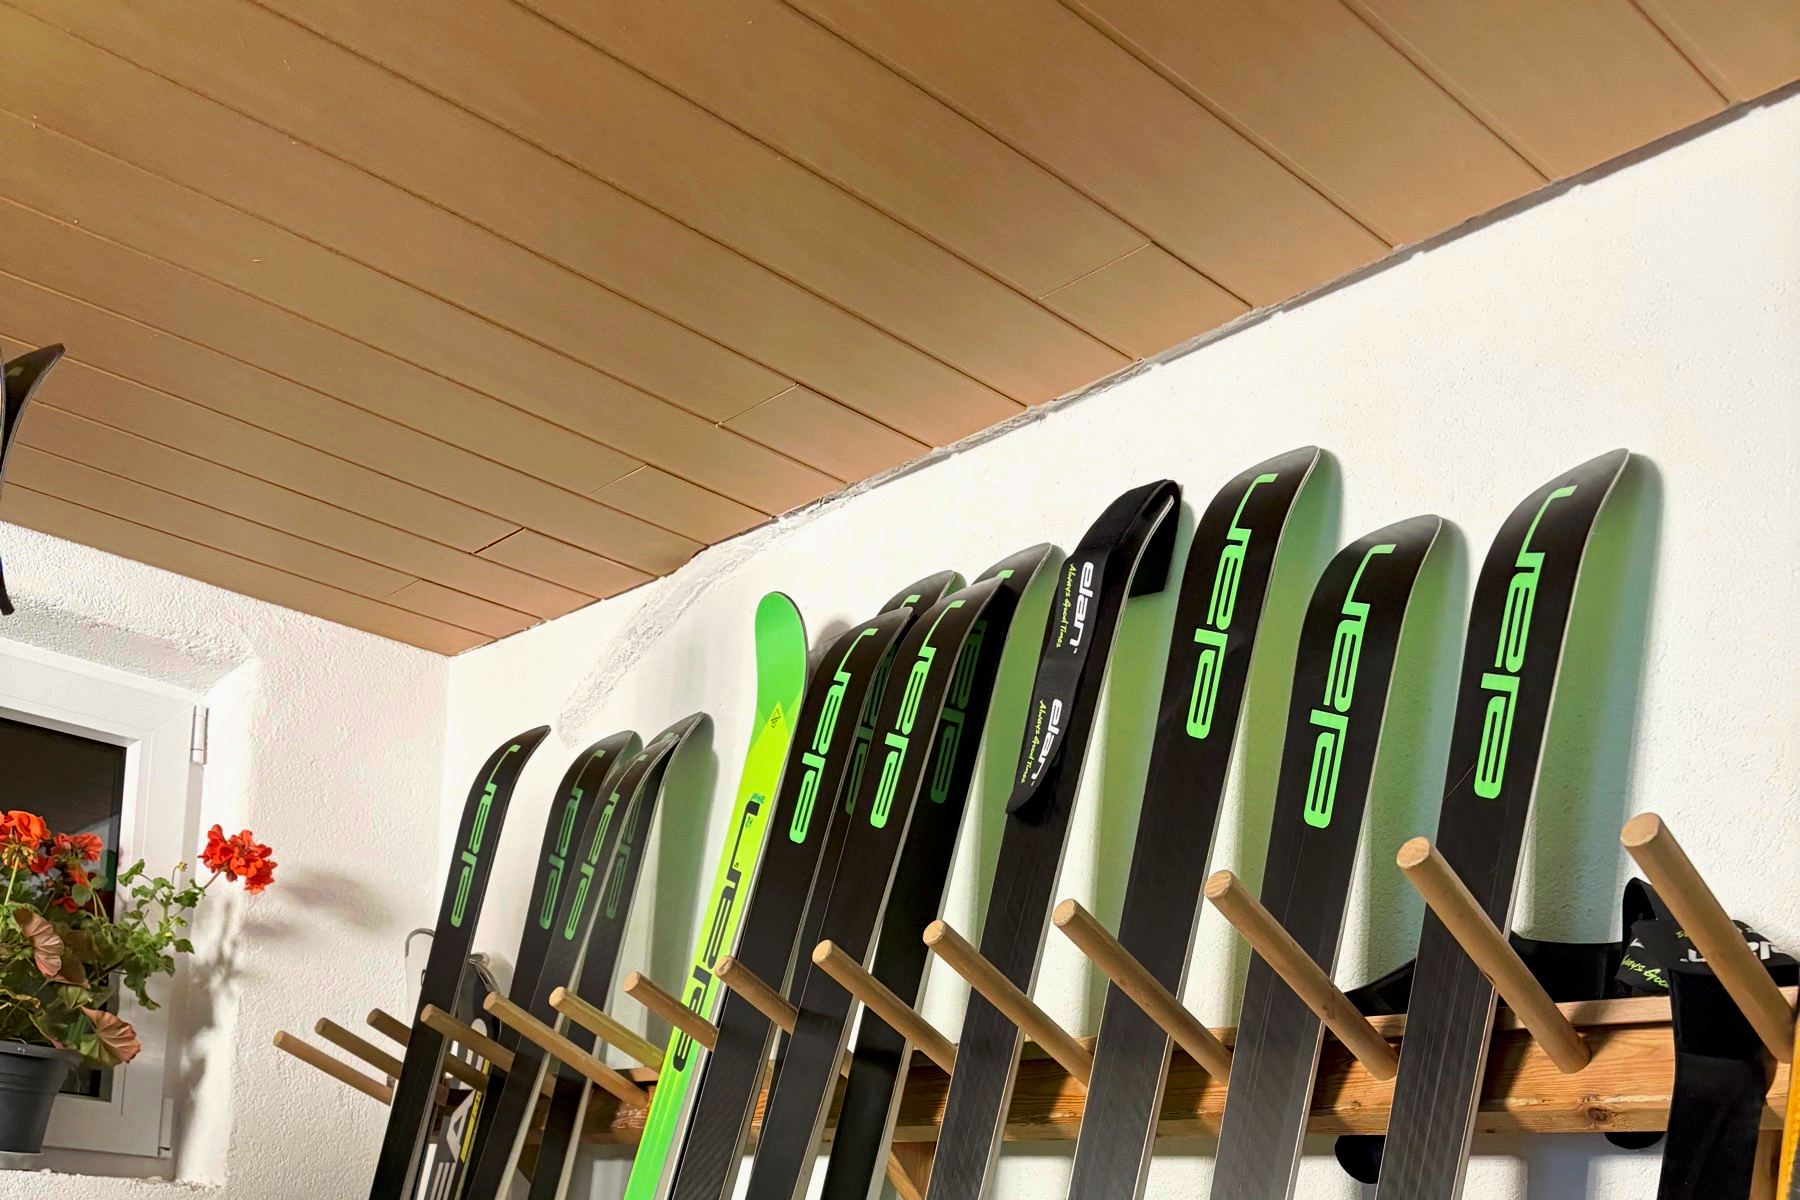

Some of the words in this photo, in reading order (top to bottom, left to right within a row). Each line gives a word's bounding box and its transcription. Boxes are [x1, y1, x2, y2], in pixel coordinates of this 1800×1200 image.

[1069, 561, 1094, 647] elan
[1186, 473, 1279, 740] elan
[1303, 543, 1397, 830] elan
[1474, 485, 1578, 800] elan
[790, 628, 878, 844] elan
[870, 600, 966, 829] elan
[1031, 698, 1062, 780] elan
[451, 744, 521, 928] elan
[539, 750, 605, 930] elan
[564, 754, 649, 941] elan
[673, 801, 760, 1073] elan
